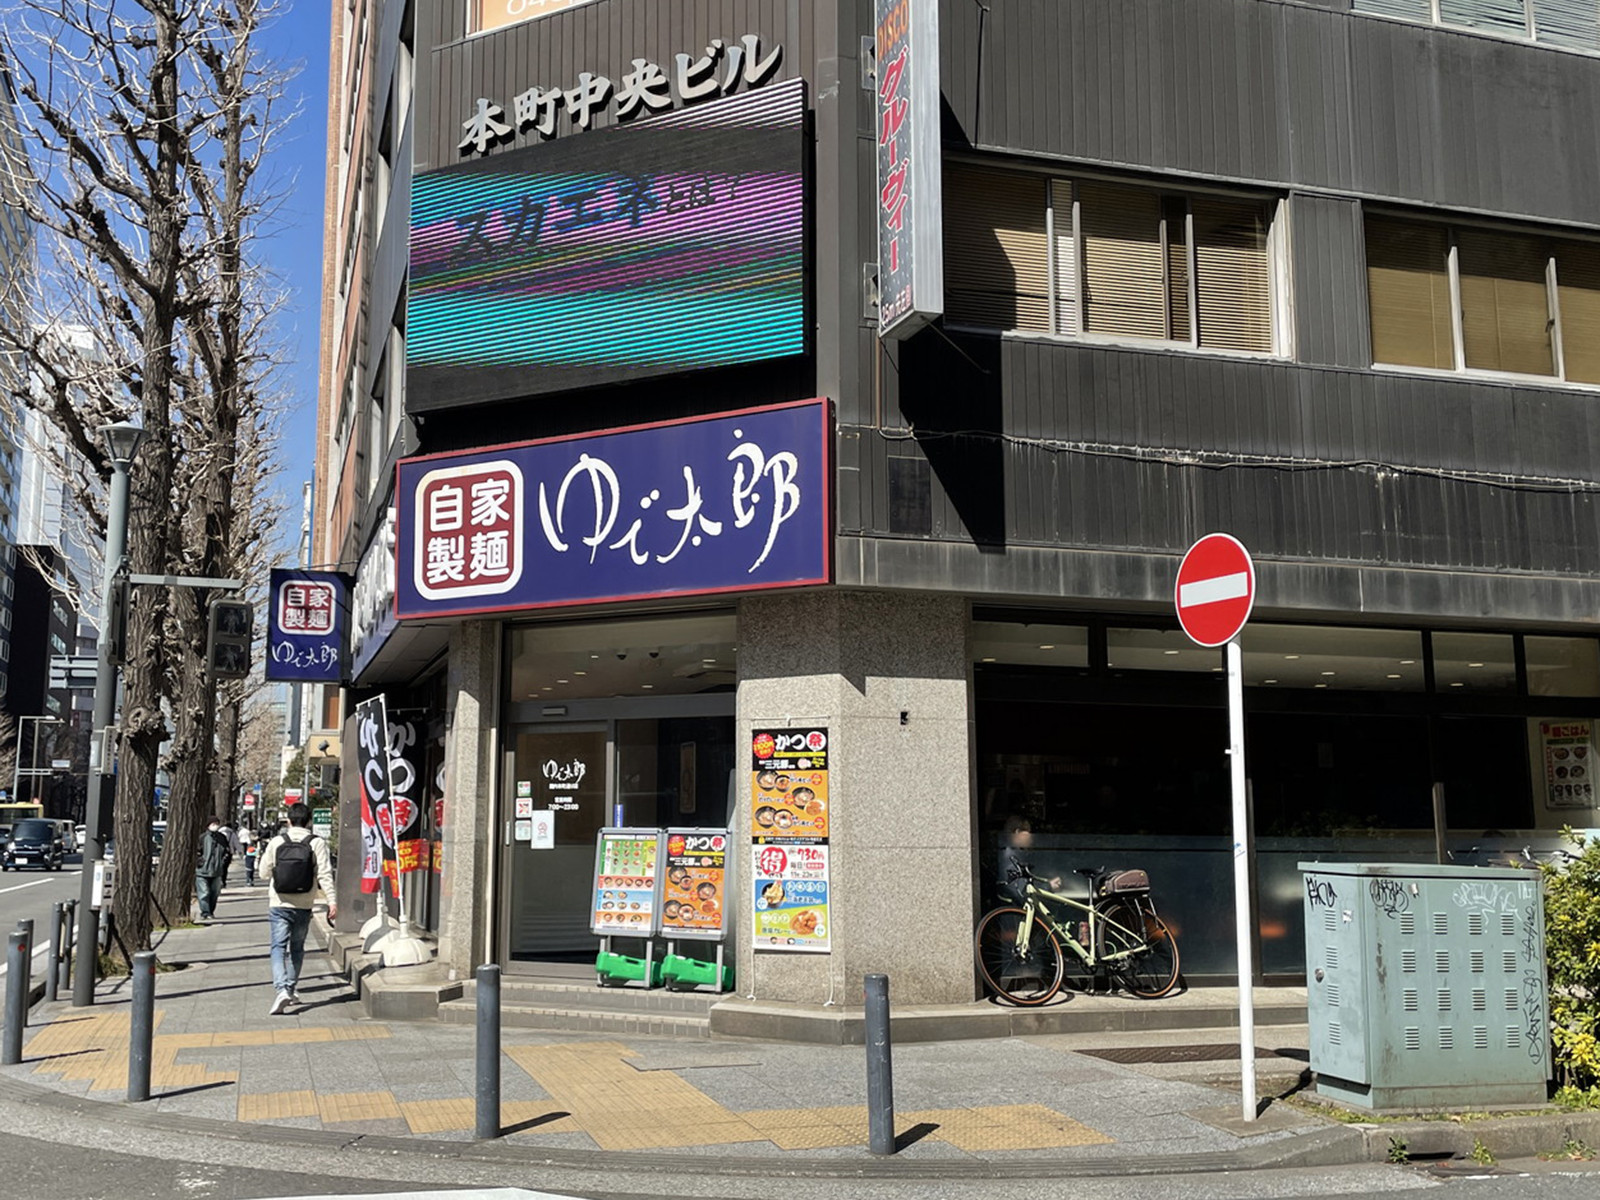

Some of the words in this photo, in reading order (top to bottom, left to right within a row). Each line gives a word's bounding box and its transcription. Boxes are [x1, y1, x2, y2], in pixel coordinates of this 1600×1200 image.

[877, 0, 909, 61] DISCO
[457, 34, 783, 155] 本町中央ビル
[879, 43, 909, 275] グルーヴィー
[429, 477, 511, 533] 自家
[538, 429, 801, 573] ゆで太郎
[427, 529, 510, 585] 製麺
[284, 607, 329, 630] 製麺
[286, 587, 330, 608] 自家
[271, 641, 338, 671] ゆで太郎
[542, 758, 586, 784] ゆで太郎
